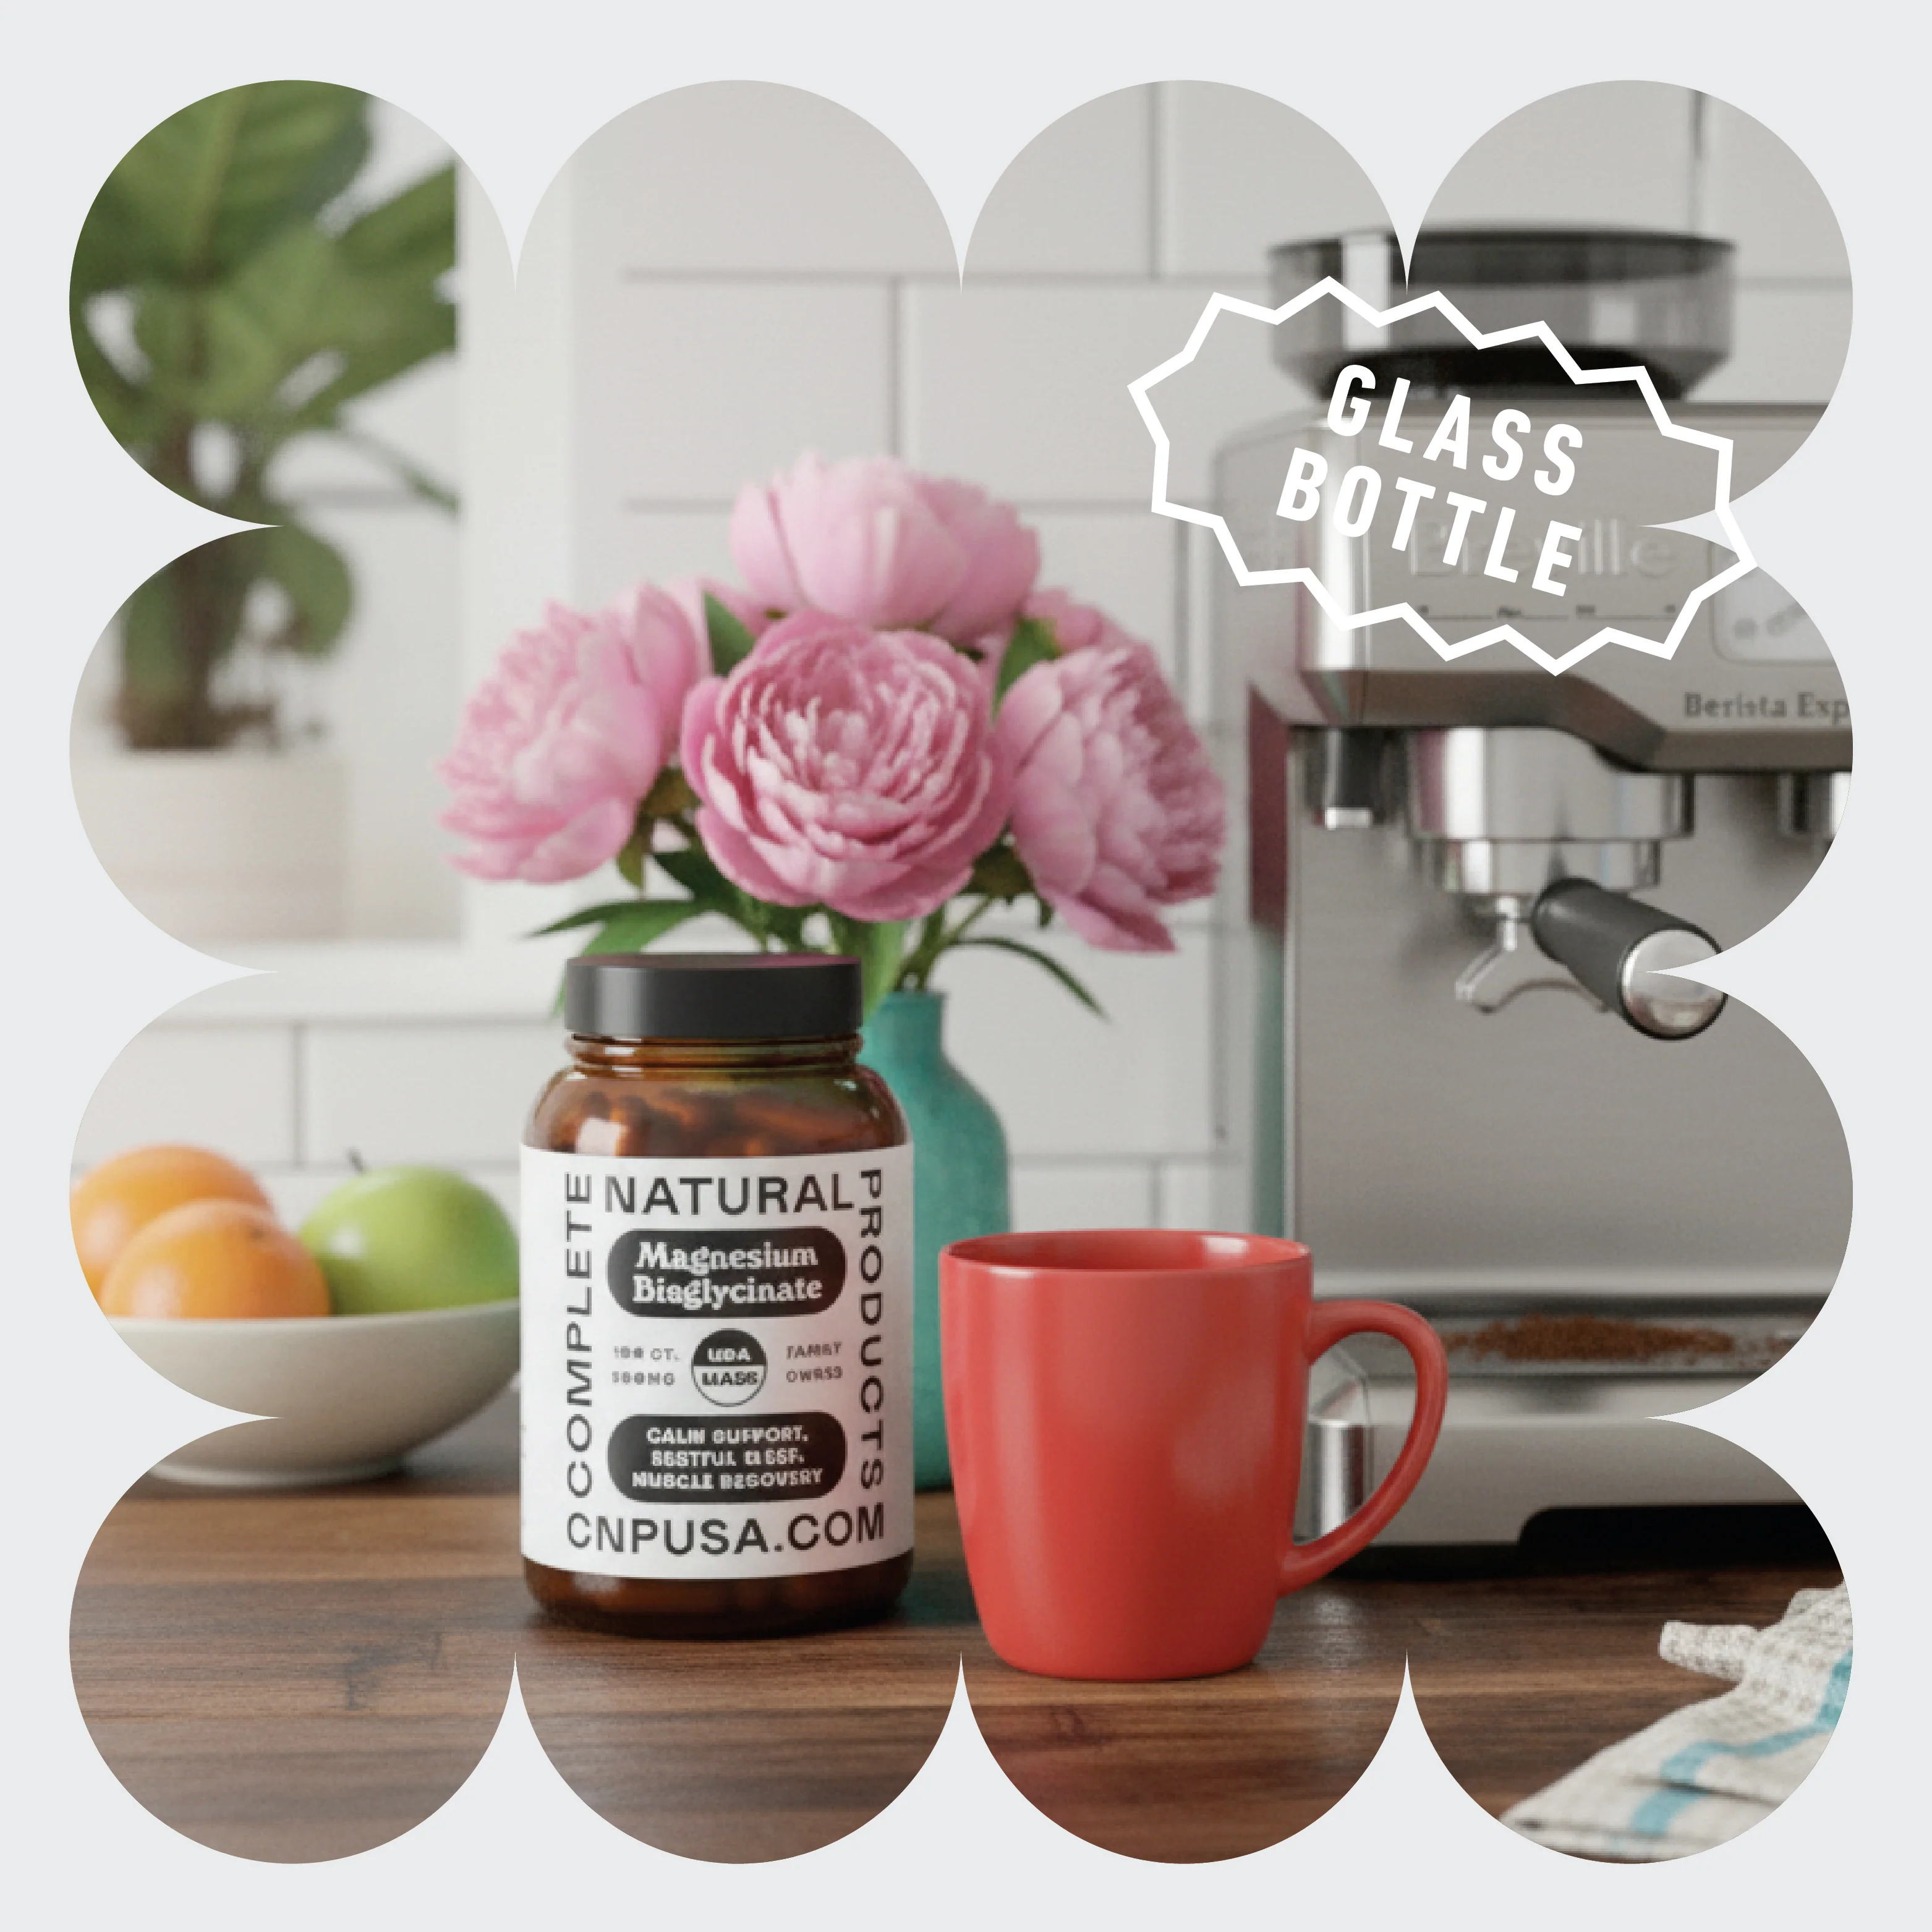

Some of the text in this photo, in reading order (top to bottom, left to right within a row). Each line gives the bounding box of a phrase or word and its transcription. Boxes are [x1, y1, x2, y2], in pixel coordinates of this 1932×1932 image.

[605, 1172, 854, 1215] NATURAL
[634, 1241, 819, 1277] Magnesium
[566, 1173, 592, 1499] COMPLETE
[858, 1169, 883, 1491] PRODUCTS
[566, 1502, 885, 1555] CNPUSA.COM
